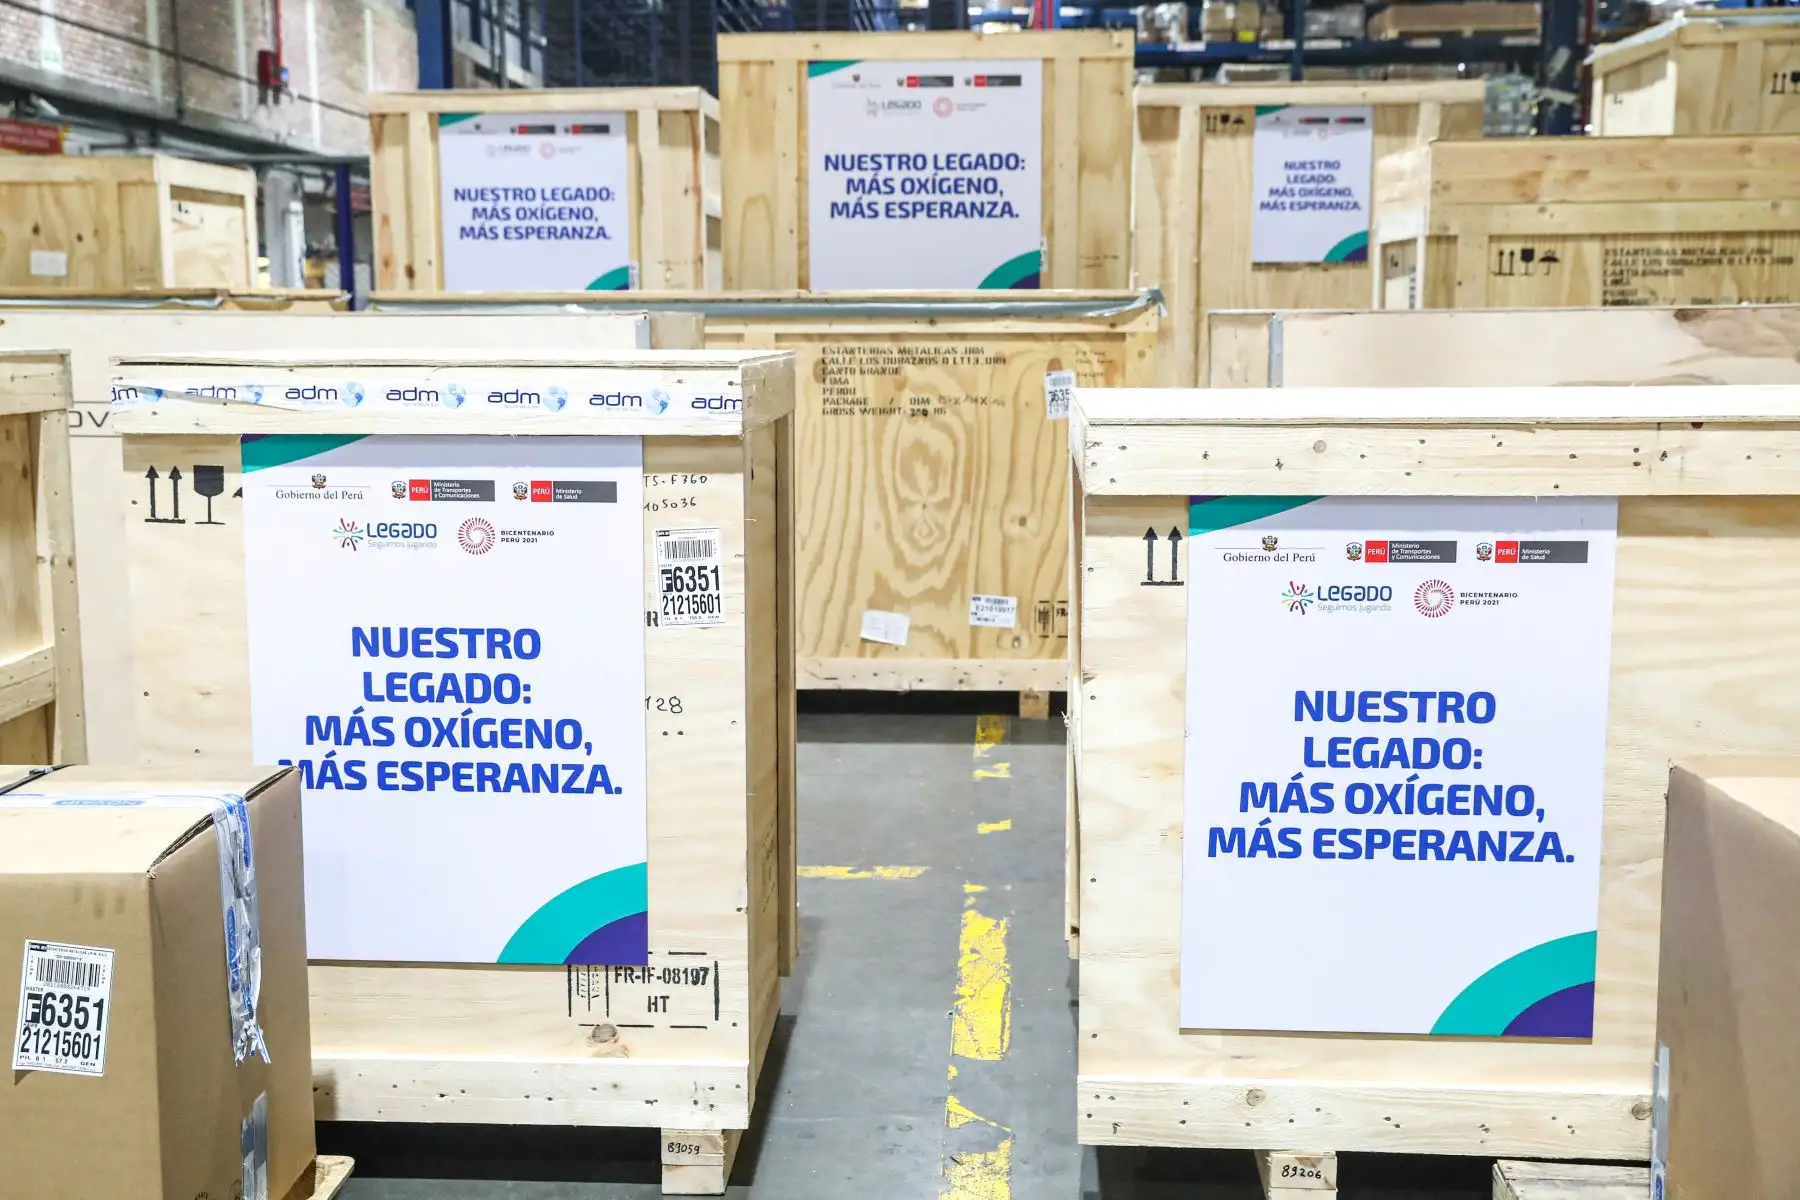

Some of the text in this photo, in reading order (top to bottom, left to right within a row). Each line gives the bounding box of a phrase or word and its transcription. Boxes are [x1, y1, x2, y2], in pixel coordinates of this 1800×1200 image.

[824, 153, 1026, 172] NUESTRO LEGADO:
[1284, 160, 1342, 170] NUESTRO
[846, 171, 1005, 197] MÁS OXÍGENO,
[1269, 186, 1296, 197] MÁS
[454, 187, 616, 202] NUESTRO LEGADO:
[472, 202, 599, 222] MÁS OXÍGENO,
[830, 195, 1020, 219] MÁS ESPERANZA.
[1260, 199, 1287, 211] MÁS
[459, 222, 612, 240] MÁS ESPERANZA.
[285, 385, 338, 400] adm
[386, 386, 439, 402] adm
[487, 388, 541, 404] adm
[589, 391, 642, 408] adm
[691, 394, 742, 410] adm
[275, 489, 364, 500] Gobierno del Perú
[411, 486, 429, 494] PERÚ
[442, 487, 472, 495] Transportes
[532, 486, 551, 495] PERÚ
[367, 540, 405, 549] Seguimos
[1367, 547, 1386, 556] PERÚ
[1400, 548, 1432, 556] Transportes
[1497, 547, 1516, 556] PERÚ
[1223, 552, 1316, 562] Gobierno del Perú
[660, 564, 720, 593] F6351
[662, 593, 721, 616] 21215601
[1317, 602, 1357, 613] Seguimos
[1460, 598, 1481, 606] PERÚ
[351, 626, 542, 660] NUESTRO
[363, 671, 532, 705] LEGADO:
[1294, 690, 1497, 724] NUESTRO
[305, 705, 593, 756] MÁS OXÍGENO,
[1304, 736, 1483, 770] LEGADO:
[377, 760, 623, 796] ESPERANZA.
[1239, 771, 1545, 823] MÁS OXÍGENO,
[1208, 817, 1575, 864] MÁS ESPERANZA.
[25, 991, 105, 1032] F6351
[647, 995, 670, 1014] HT
[20, 1026, 101, 1060] 21215601
[1281, 1164, 1322, 1180] 89206
